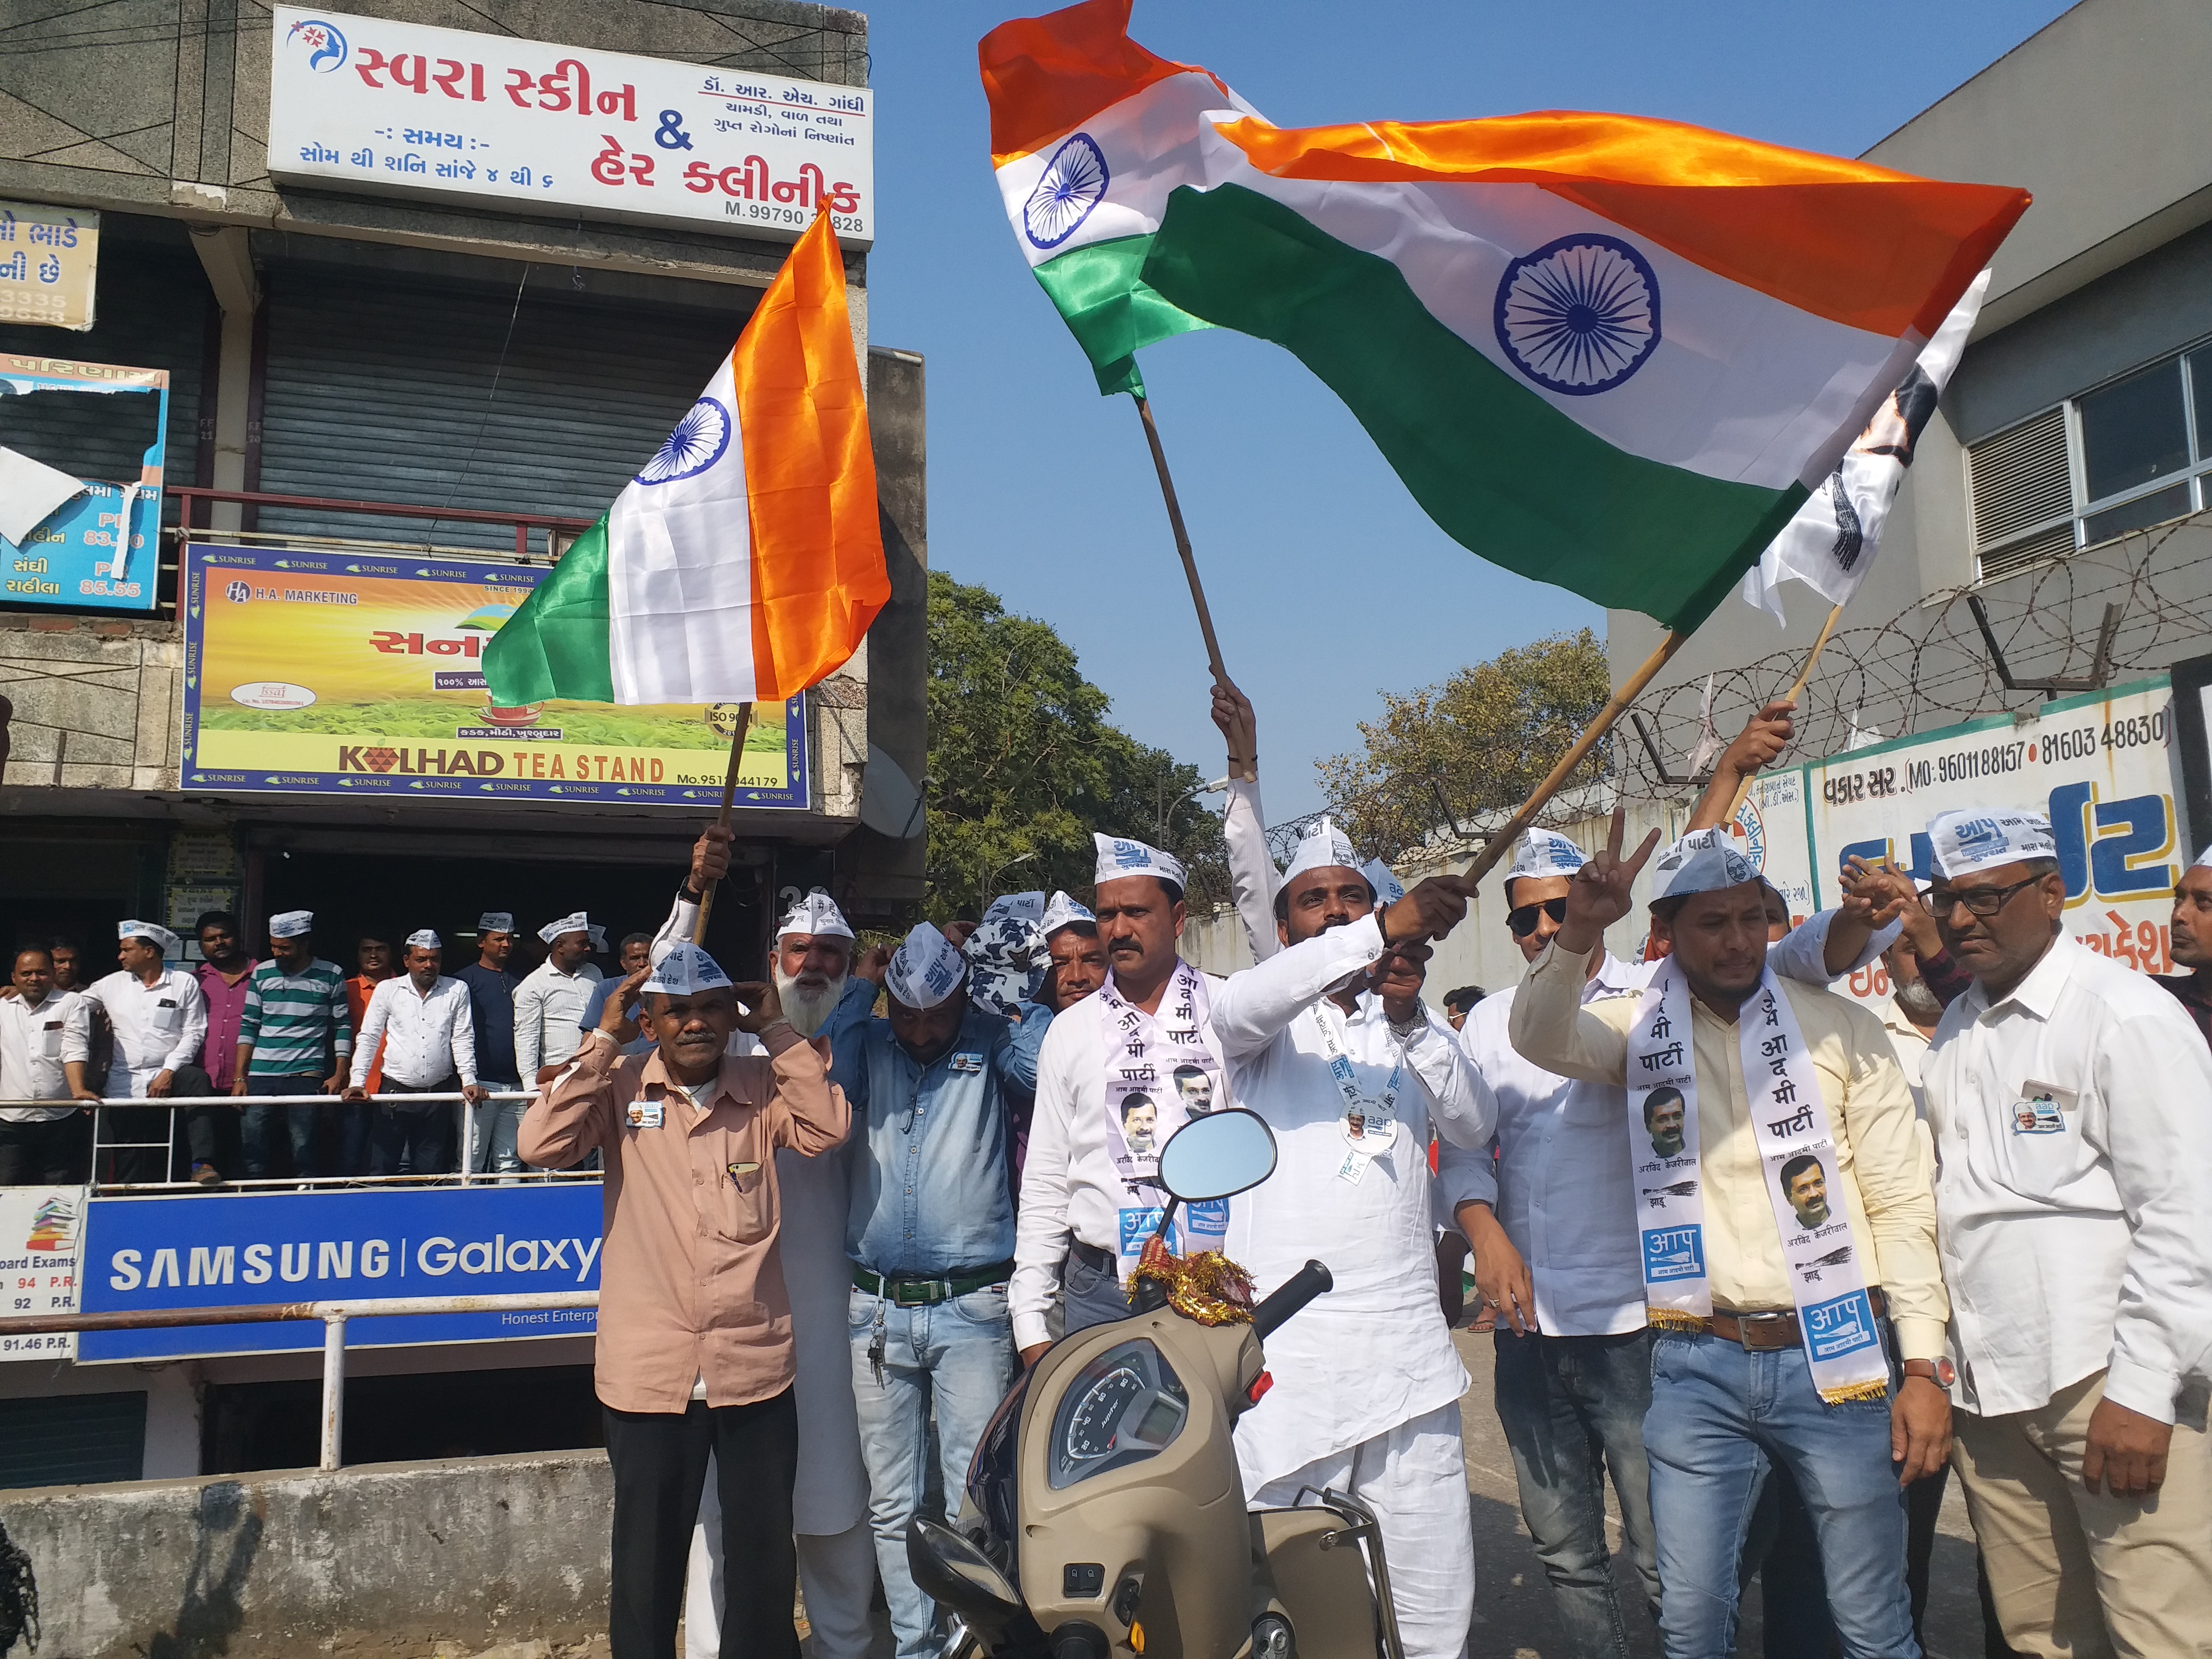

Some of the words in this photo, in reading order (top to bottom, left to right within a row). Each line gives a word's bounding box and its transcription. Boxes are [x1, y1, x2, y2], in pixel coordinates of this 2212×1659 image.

[355, 48, 487, 102] સ્વરા
[505, 59, 638, 121] સ્કીન
[736, 84, 772, 99] આર.
[783, 87, 818, 106] એચ.
[829, 95, 865, 112] ગાંધી
[726, 102, 772, 119] ચામડી,
[781, 111, 808, 122] વાળ
[816, 116, 842, 127] તથા
[655, 109, 694, 151] &
[714, 119, 742, 132] ગુપ્ત
[750, 121, 797, 138] રોગોનાં
[805, 128, 854, 146] નિષ્ણાંત
[403, 128, 463, 150] સમય
[300, 141, 339, 164] સોમ
[350, 148, 374, 168] થી
[384, 153, 426, 174] શનિ
[435, 159, 476, 180] સાંજે
[486, 168, 499, 182] ૪
[509, 166, 531, 186] થી
[591, 134, 655, 187] હેર
[683, 155, 861, 214] ક્લીનીક
[30, 217, 77, 248] ભાડે
[39, 253, 60, 283] છે
[84, 530, 144, 548] 83.0
[218, 555, 256, 565] SUNRISE
[291, 561, 328, 570] SUNRISE
[362, 565, 398, 575] SUNRISE
[432, 569, 467, 578] SUNRISE
[500, 574, 535, 583] SUNRISE
[6, 576, 60, 594] રાહીલા
[80, 579, 141, 597] 85.55
[191, 572, 200, 604] SUNRISE
[255, 589, 280, 600] H.A.
[285, 590, 358, 605] MARKETING
[188, 642, 198, 674] SUNRISE
[710, 711, 726, 721] ISO
[184, 712, 193, 745] SUNRISE
[513, 752, 566, 779] TEA
[577, 755, 665, 783] STAND
[1824, 772, 1865, 806] વકાર
[1868, 767, 1898, 797] સર
[1938, 741, 2025, 783] 9601188157
[2042, 726, 2096, 765] 81603
[207, 774, 246, 783] SUNRISE
[281, 776, 319, 784] SUNRISE
[354, 778, 391, 787] SUNRISE
[426, 781, 462, 789] SUNRISE
[496, 782, 531, 791] SUNRISE
[564, 785, 599, 793] SUNRISE
[632, 788, 666, 796] SUNRISE
[1955, 818, 2002, 839] આપ
[1999, 817, 2024, 826] આમ
[668, 974, 679, 985] દેશ
[1639, 1041, 1684, 1071] पार्टी
[1119, 1063, 1156, 1082] पार्टी
[1675, 1074, 1691, 1084] पार्टी
[1368, 1115, 1392, 1133] aap
[1767, 1104, 1814, 1139] पार्टी
[1812, 1139, 1828, 1150] पार्टी
[1638, 1161, 1661, 1173] अरविंद
[1664, 1157, 1696, 1169] केजरीवाल
[1787, 1233, 1811, 1247] अरविंद
[1814, 1222, 1848, 1240] केजरीवाल
[1649, 1229, 1696, 1263] आप
[33, 1256, 76, 1268] Exams
[110, 1238, 389, 1291] SAMSUNG
[418, 1234, 602, 1282] Galaxy
[18, 1277, 36, 1289] 94
[50, 1276, 78, 1288] P.R.
[14, 1298, 31, 1309] 92
[51, 1296, 75, 1308] P.R.
[502, 1311, 549, 1325] Honest
[1810, 1295, 1861, 1332] आप
[4, 1338, 42, 1351] 91.46
[47, 1337, 71, 1348] P.R.
[1120, 1378, 1129, 1388] 80
[1098, 1392, 1106, 1402] 60
[1082, 1416, 1092, 1426] 40
[1101, 1398, 1119, 1429] Jupiter
[1081, 1440, 1091, 1451] 20
